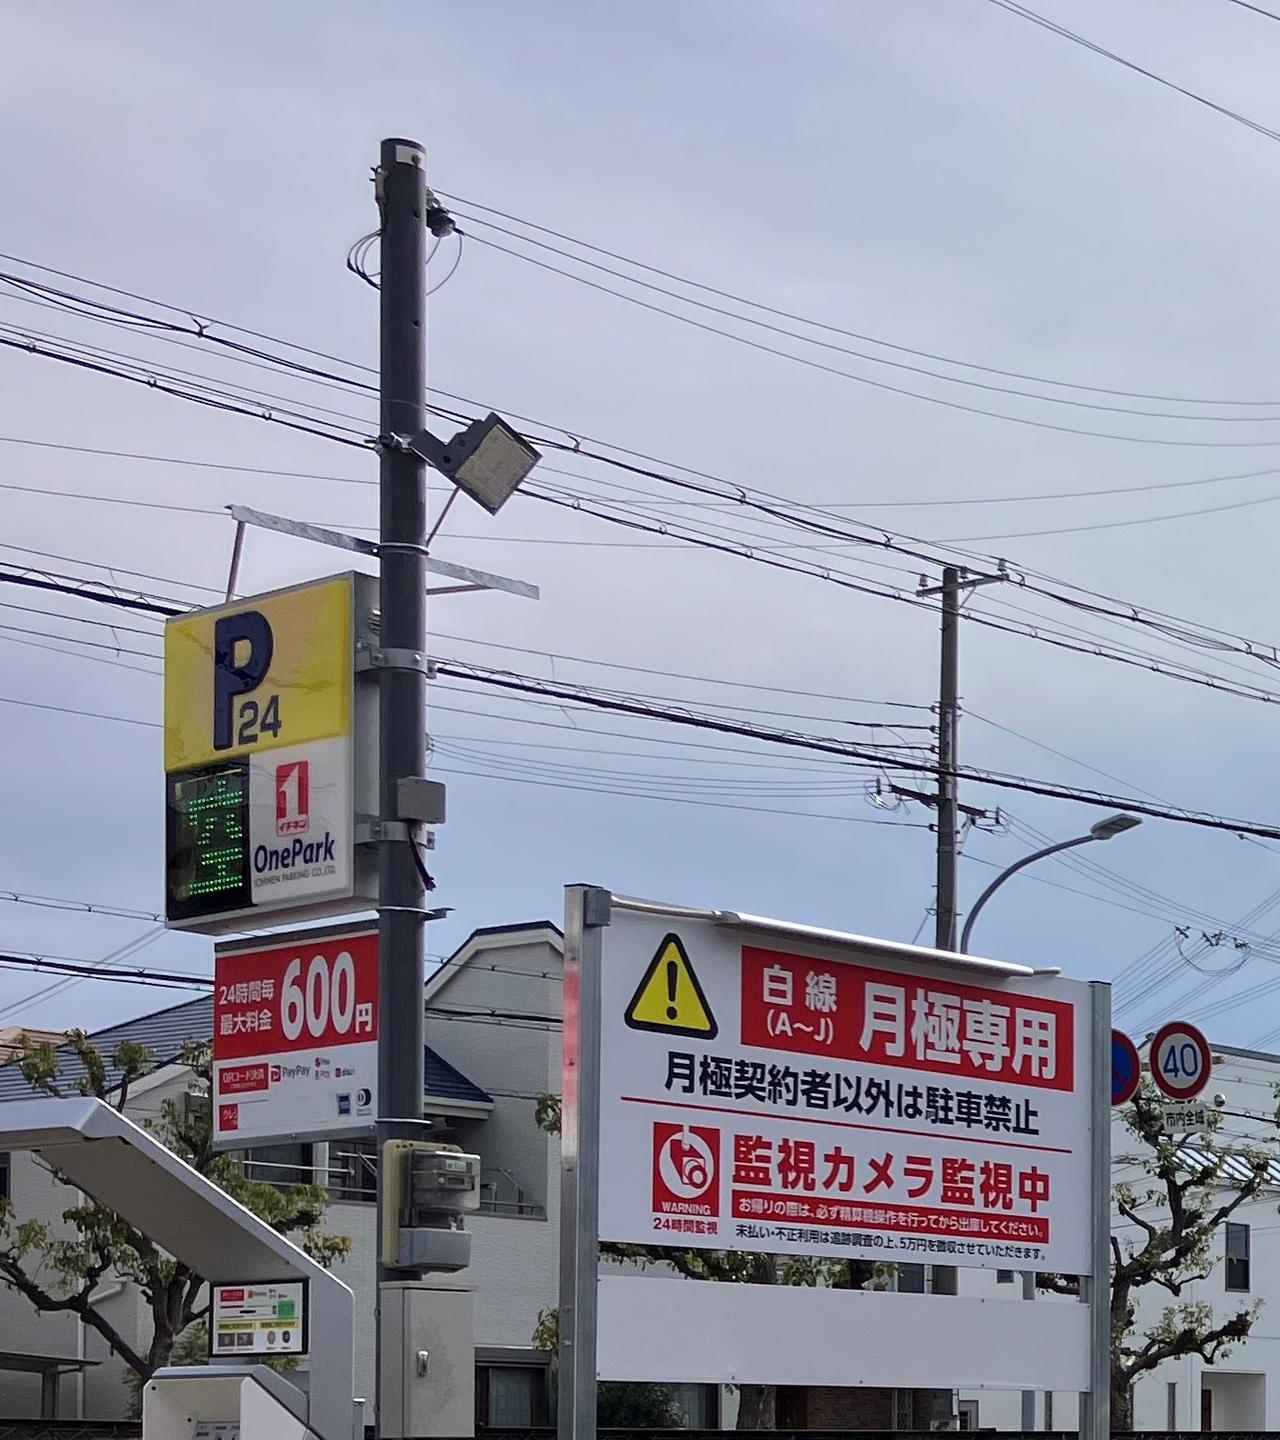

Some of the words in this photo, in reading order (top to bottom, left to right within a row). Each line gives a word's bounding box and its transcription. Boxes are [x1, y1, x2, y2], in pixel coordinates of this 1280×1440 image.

[213, 610, 273, 750] P
[238, 694, 282, 746] 24
[254, 832, 335, 873] OnePark
[218, 979, 275, 1006] 24時間毎
[762, 963, 838, 1013] 白線
[220, 1008, 272, 1035] 最大料金
[859, 981, 1058, 1080] 月極専用
[1163, 1043, 1199, 1078] 40
[665, 1051, 1040, 1136] 月極契約者以外は駐車禁止
[1165, 1109, 1205, 1127] 市内全域
[732, 1134, 1051, 1213] 監視カメラ監視中
[653, 1217, 719, 1236] 24時間監視
[661, 1201, 711, 1216] WARNING
